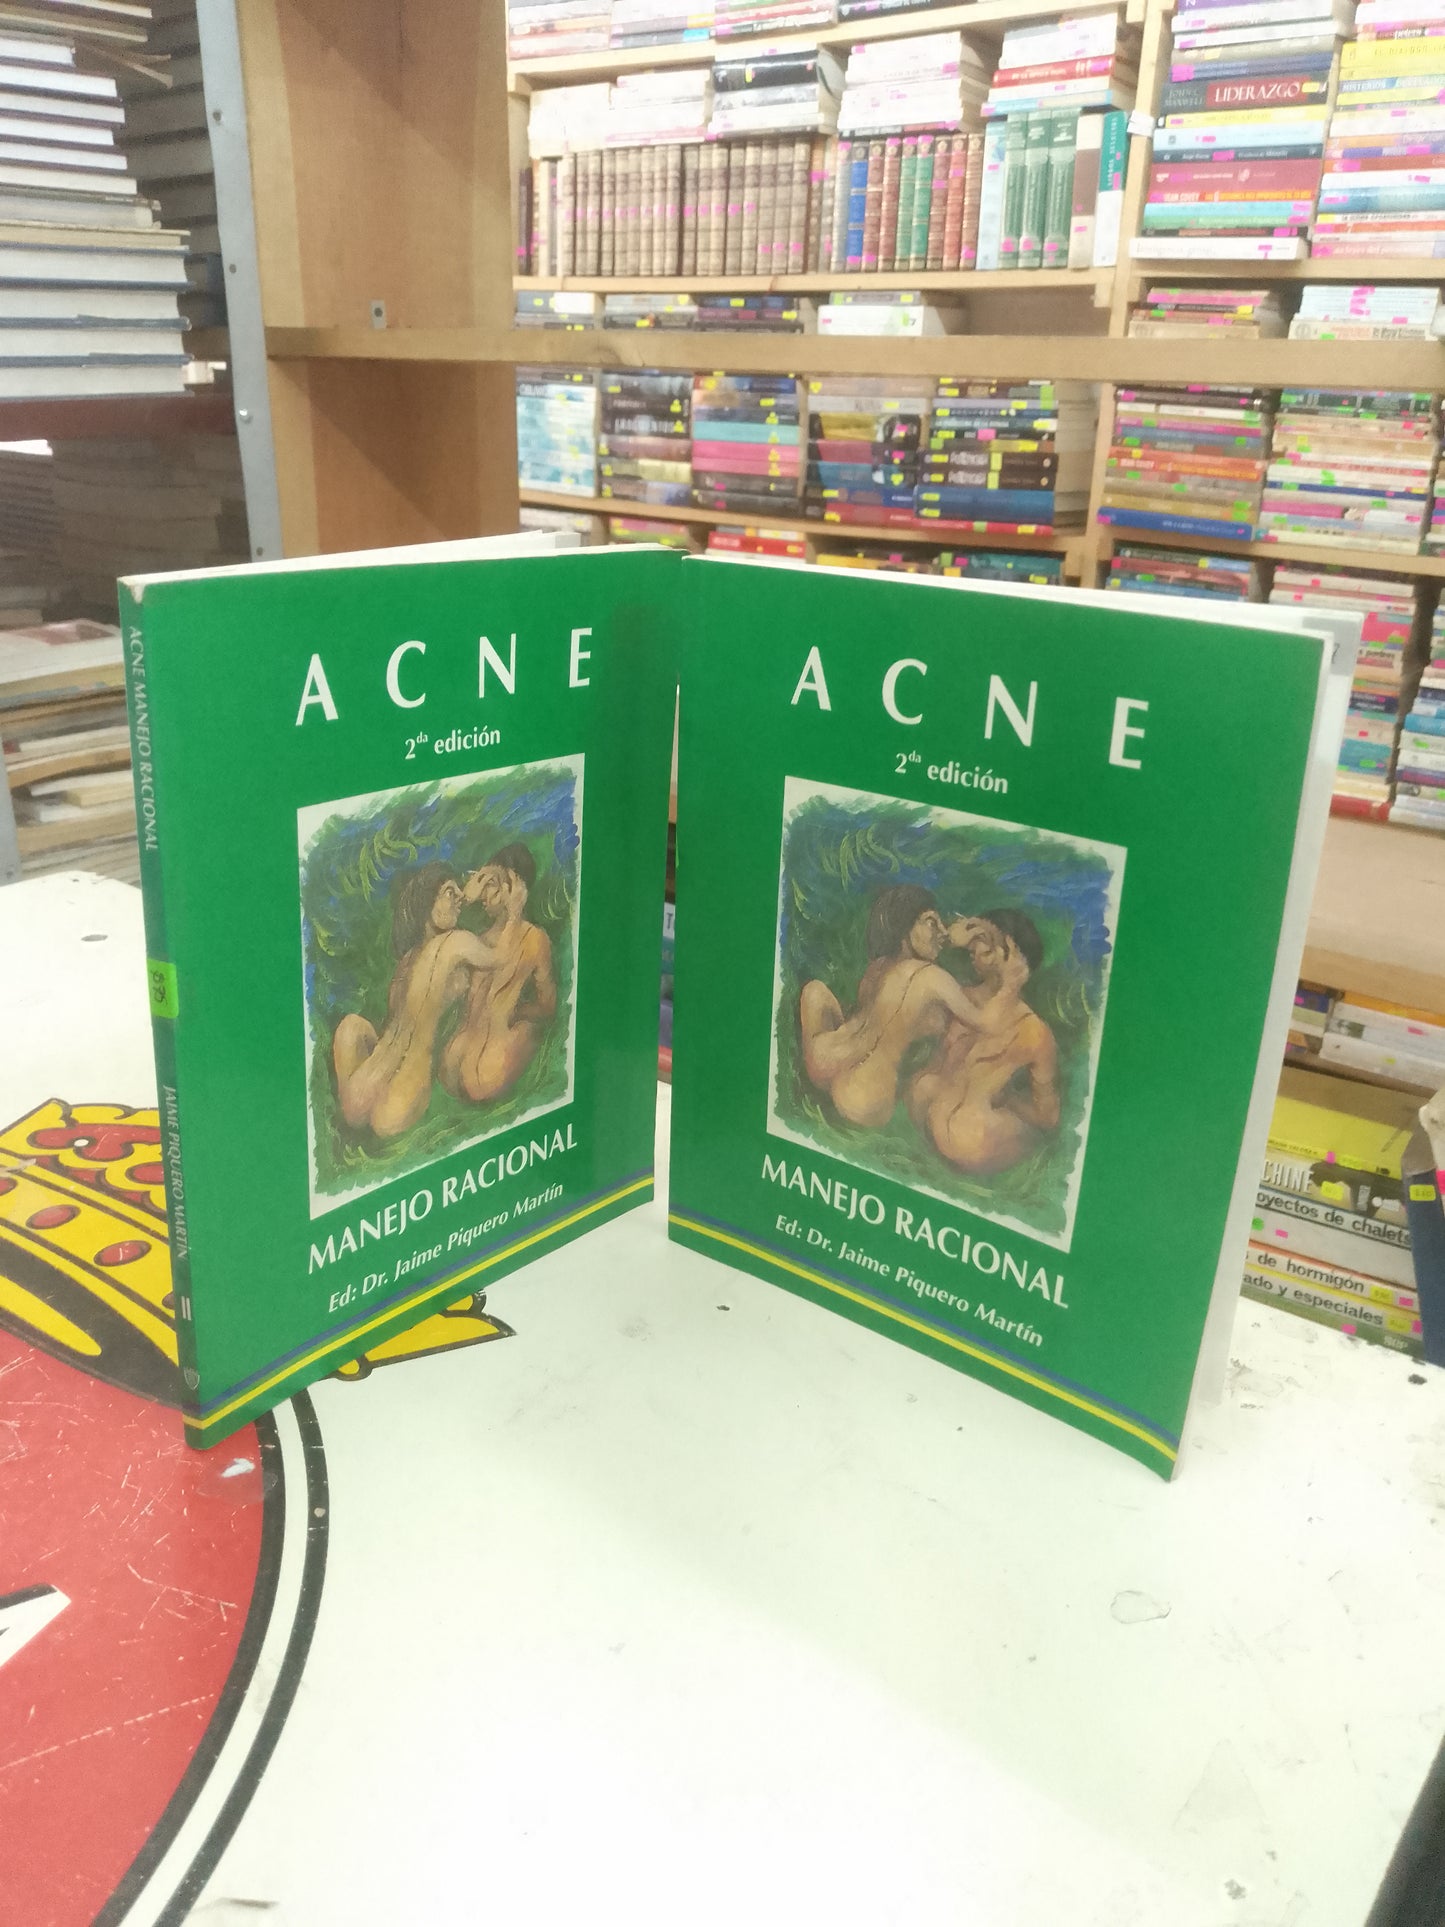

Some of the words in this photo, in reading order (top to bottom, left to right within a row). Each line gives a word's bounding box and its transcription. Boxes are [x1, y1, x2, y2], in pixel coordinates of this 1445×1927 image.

[1214, 81, 1301, 103] LIDERAZGO
[128, 626, 146, 677] ACNE
[296, 626, 592, 726] ACNE
[134, 682, 152, 758] MANEJO
[791, 646, 1149, 770] ACNE
[434, 725, 501, 755] edición
[140, 761, 159, 851] RACIONAL
[927, 761, 1008, 794] edición
[163, 1084, 181, 1129] JAIME
[168, 1132, 185, 1200] PIQUERO
[308, 1189, 433, 1275] MANEJO
[442, 1123, 578, 1208] RACIONAL
[1324, 1209, 1344, 1226] de
[174, 1204, 192, 1259] MARTÍN
[328, 1284, 356, 1313] Ed:
[362, 1274, 388, 1297] Dr.
[394, 1243, 442, 1282] Jaime
[447, 1211, 508, 1251] Piquero
[513, 1182, 564, 1219] Martín
[761, 1154, 886, 1225] MANEJO
[895, 1206, 1069, 1309] RACIONAL
[1257, 1252, 1277, 1268] de
[775, 1214, 801, 1239] Ed:
[806, 1228, 833, 1253] Dr.
[838, 1241, 890, 1276] Jaime
[895, 1266, 969, 1312] Piquero
[974, 1303, 1043, 1347] Martín
[1278, 1286, 1288, 1297] y
[1293, 1290, 1383, 1325] especiales
